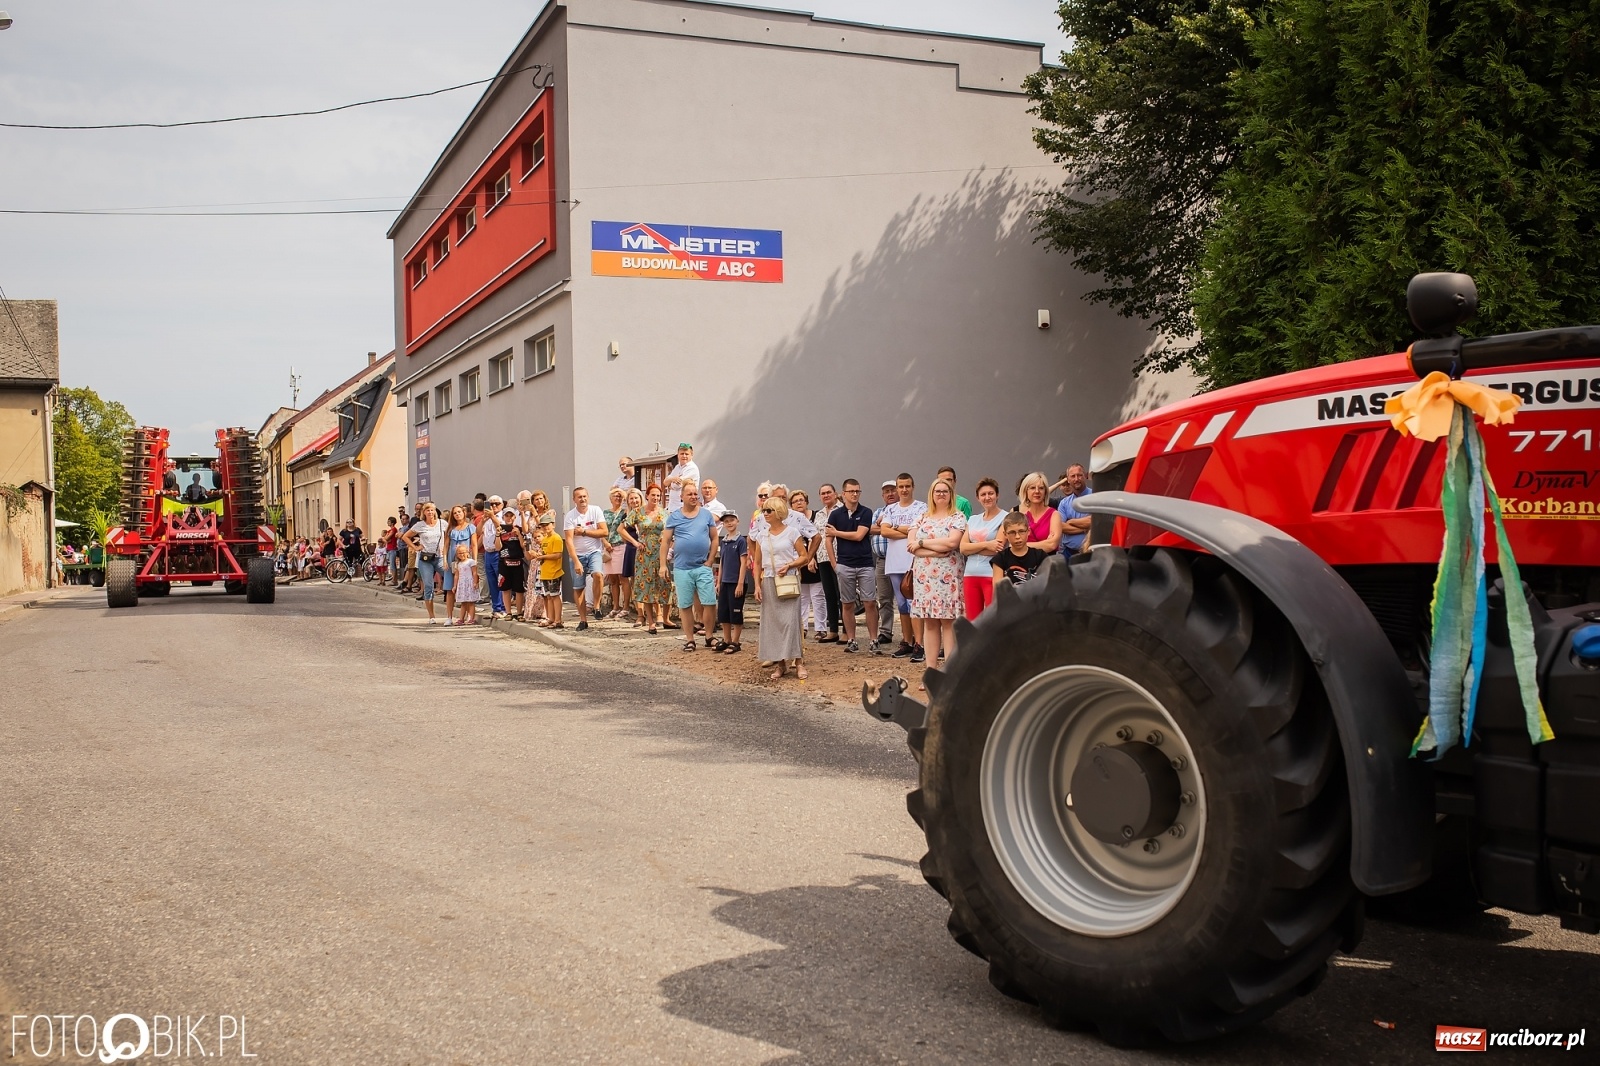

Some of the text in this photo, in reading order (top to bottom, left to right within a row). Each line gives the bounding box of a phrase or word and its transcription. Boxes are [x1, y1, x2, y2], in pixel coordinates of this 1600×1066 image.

[621, 257, 756, 277] BUDOWLANE ABC
[1318, 390, 1406, 420] MAS
[1508, 429, 1600, 453] 771
